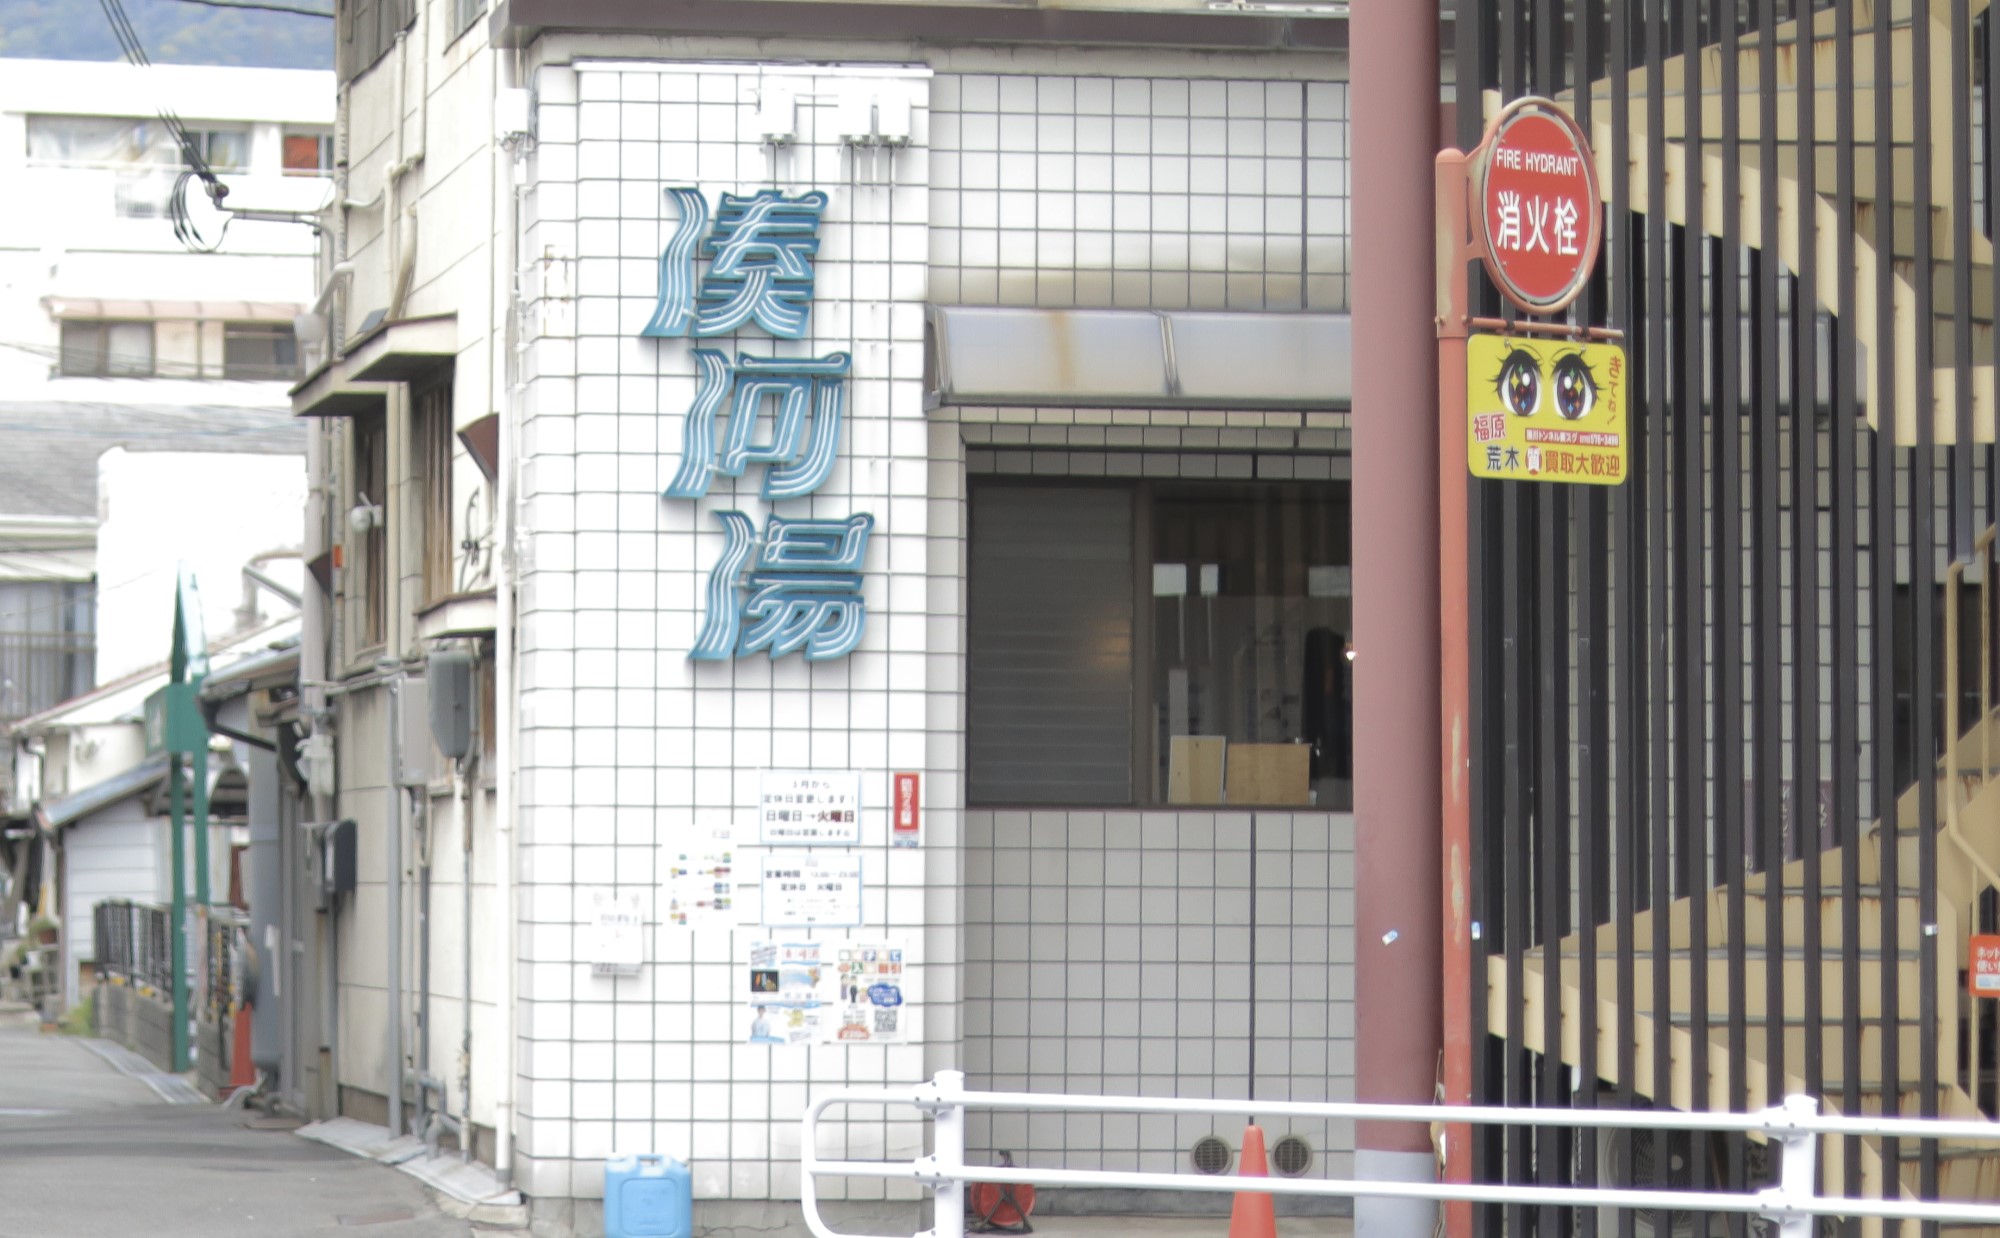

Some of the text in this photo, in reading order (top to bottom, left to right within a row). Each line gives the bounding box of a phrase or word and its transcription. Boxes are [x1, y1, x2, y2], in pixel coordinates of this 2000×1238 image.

[1496, 148, 1578, 176] FIRE HYDRANT
[1497, 190, 1579, 256] 消火栓
[640, 186, 874, 661] 湊河湯
[1473, 413, 1506, 442] 福原
[1487, 445, 1519, 471] 荒木
[1545, 450, 1620, 476] 買取大歓迎
[1976, 959, 2000, 974] 使い
